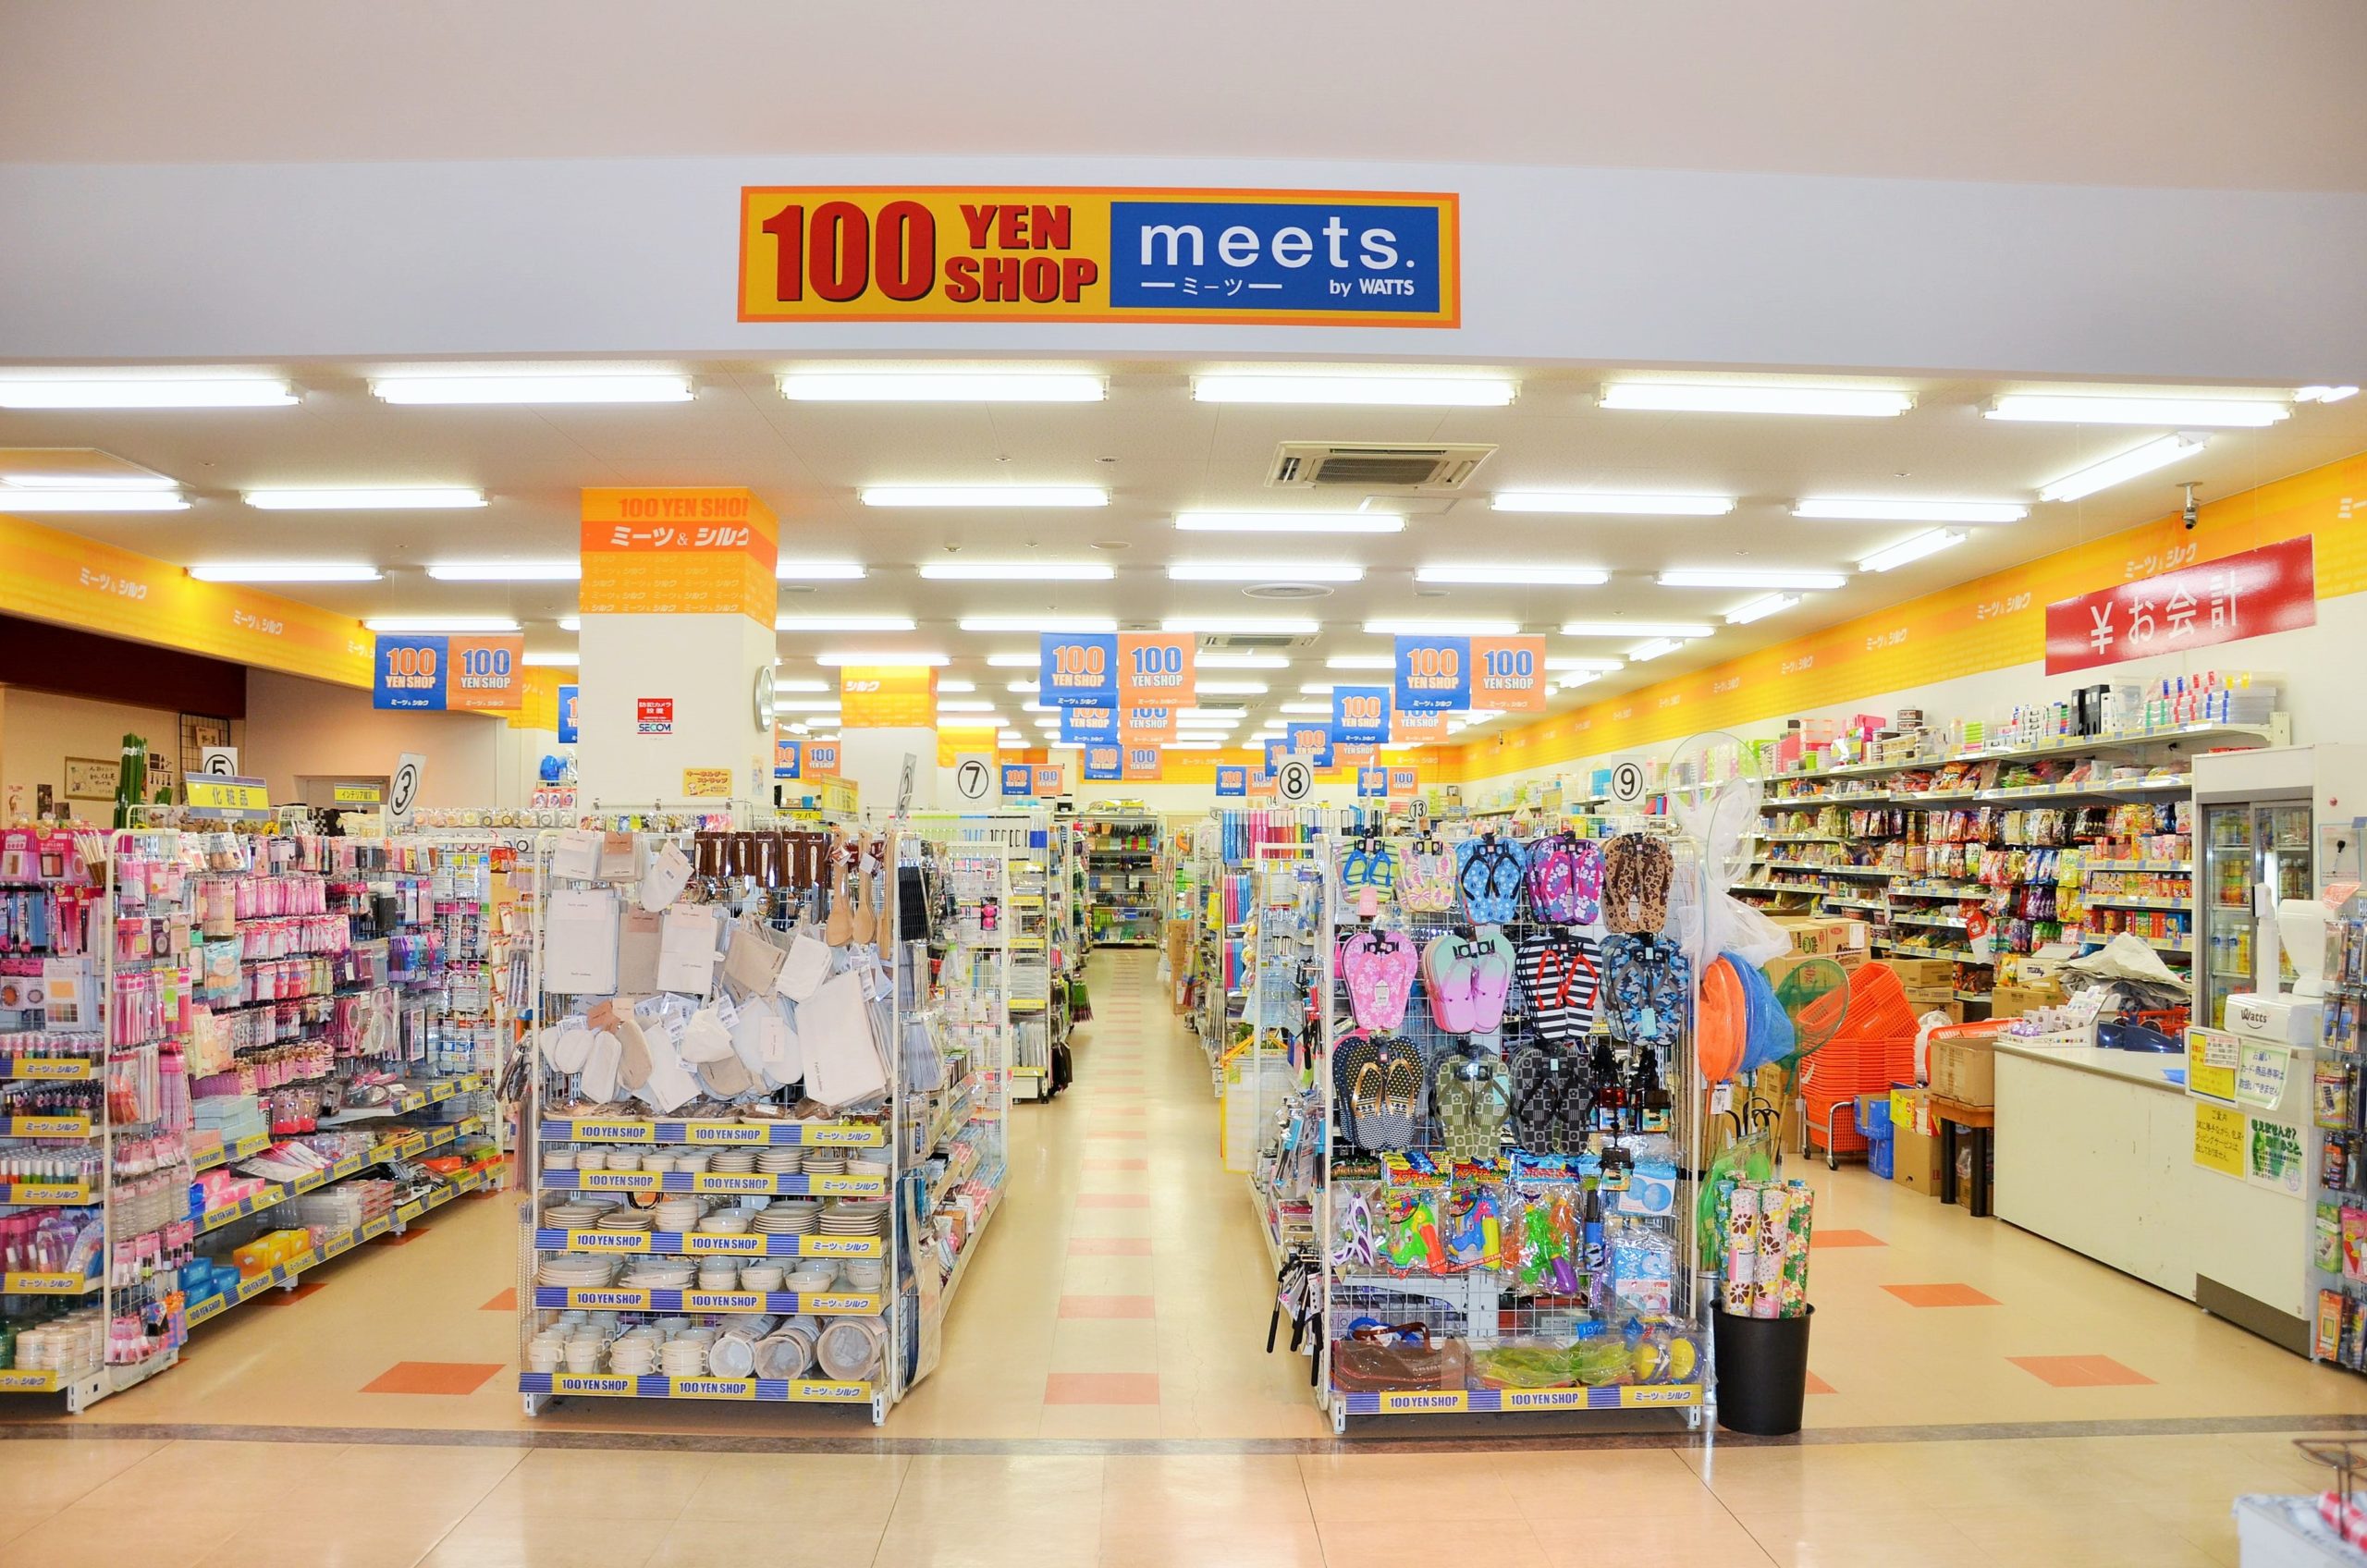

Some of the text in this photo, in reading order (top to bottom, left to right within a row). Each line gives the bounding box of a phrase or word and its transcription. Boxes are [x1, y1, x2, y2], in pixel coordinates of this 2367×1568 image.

[959, 204, 1071, 250] YEN
[1141, 215, 1415, 270] meets.
[761, 200, 936, 302] 100
[944, 256, 1098, 303] SHOP
[1329, 279, 1415, 298] by WATTS
[619, 497, 658, 518] 100
[661, 497, 697, 518] YEN
[386, 647, 436, 676] 100
[461, 649, 510, 676] 100
[1052, 645, 1105, 674] 100
[1131, 646, 1183, 675] 100
[1407, 648, 1458, 677] 100
[1483, 650, 1534, 677] 100
[386, 676, 435, 688] YEN SHOP
[460, 677, 510, 688] YEN SHOP
[1052, 674, 1105, 687] YEN SHOP
[1131, 675, 1183, 687] YEN SHOP
[1407, 677, 1459, 689] YEN SHOP
[1483, 678, 1533, 689] YEN SHOP
[1342, 696, 1380, 717] 100
[567, 718, 578, 728] YE
[639, 723, 671, 731] SECOM
[1070, 718, 1110, 729] YEN SHOP
[1129, 719, 1168, 729] YEN SHOP
[1342, 718, 1380, 728] YEN SHOP
[1401, 717, 1438, 728] YEN SHOP
[1294, 730, 1326, 747] 100
[1090, 749, 1117, 764] 100
[1131, 750, 1155, 763] 100
[1308, 747, 1325, 755] SHOP
[2240, 1007, 2267, 1023] Watts
[582, 1127, 645, 1138] 100 YEN SHOP
[695, 1129, 760, 1140] 100 YEN SHOP
[589, 1176, 653, 1186] 100 YEN SHOP
[703, 1178, 767, 1189] 100 YEN SHOP
[577, 1235, 642, 1246] 100 YEN SHOP
[692, 1238, 757, 1249] 100 YEN SHOP
[577, 1293, 641, 1305] 100 YEN SHOP
[692, 1295, 757, 1306] 100 YEN SHOP
[190, 1301, 221, 1321] 100 YEN SHOP
[561, 1378, 628, 1390] 100 YEN SHOP
[679, 1381, 746, 1393] 100 YEN SHOP
[1390, 1396, 1458, 1407] 100 YEN SHOP
[1511, 1393, 1578, 1405] 100 YEN SHOP
